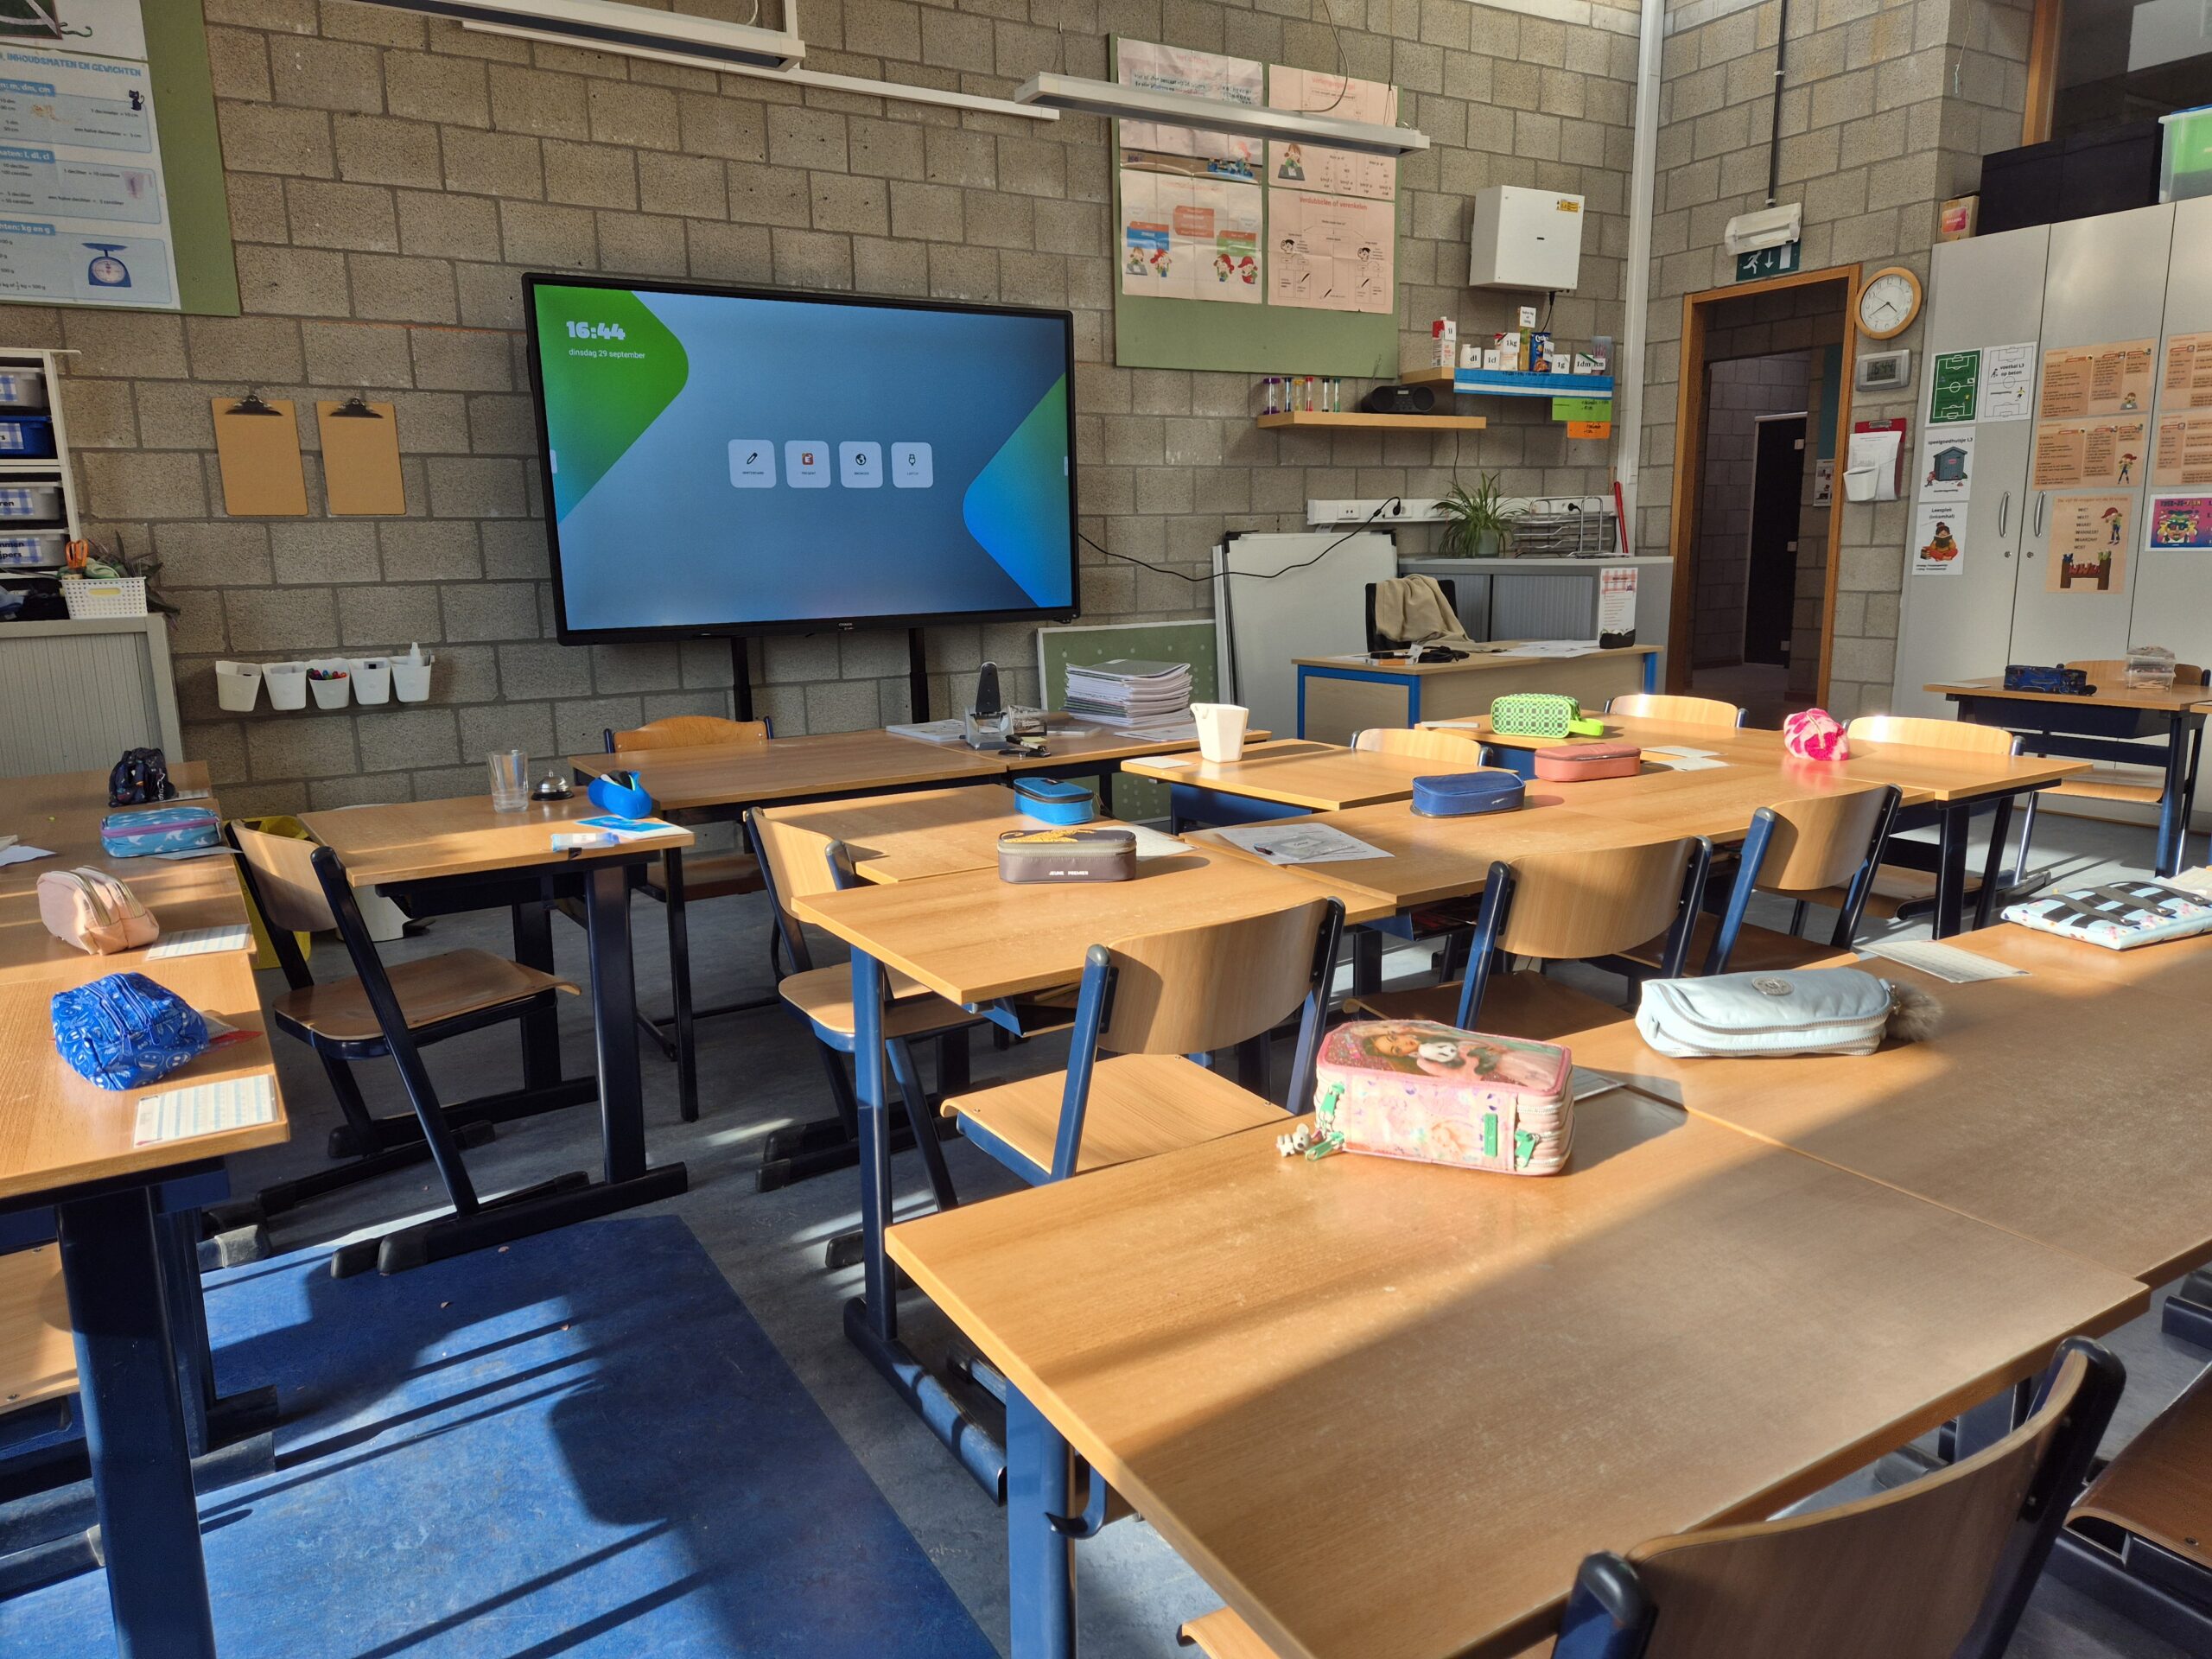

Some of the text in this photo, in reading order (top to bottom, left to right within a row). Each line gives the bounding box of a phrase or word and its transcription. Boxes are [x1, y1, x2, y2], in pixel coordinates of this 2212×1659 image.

[7, 53, 77, 68] INHOUDSMATEN
[92, 64, 141, 76] GEWICHTEN
[1300, 197, 1332, 206] Verdubbelen
[1340, 201, 1367, 210] verenkelen
[566, 321, 626, 340] 16:44
[569, 348, 597, 358] dinsdag
